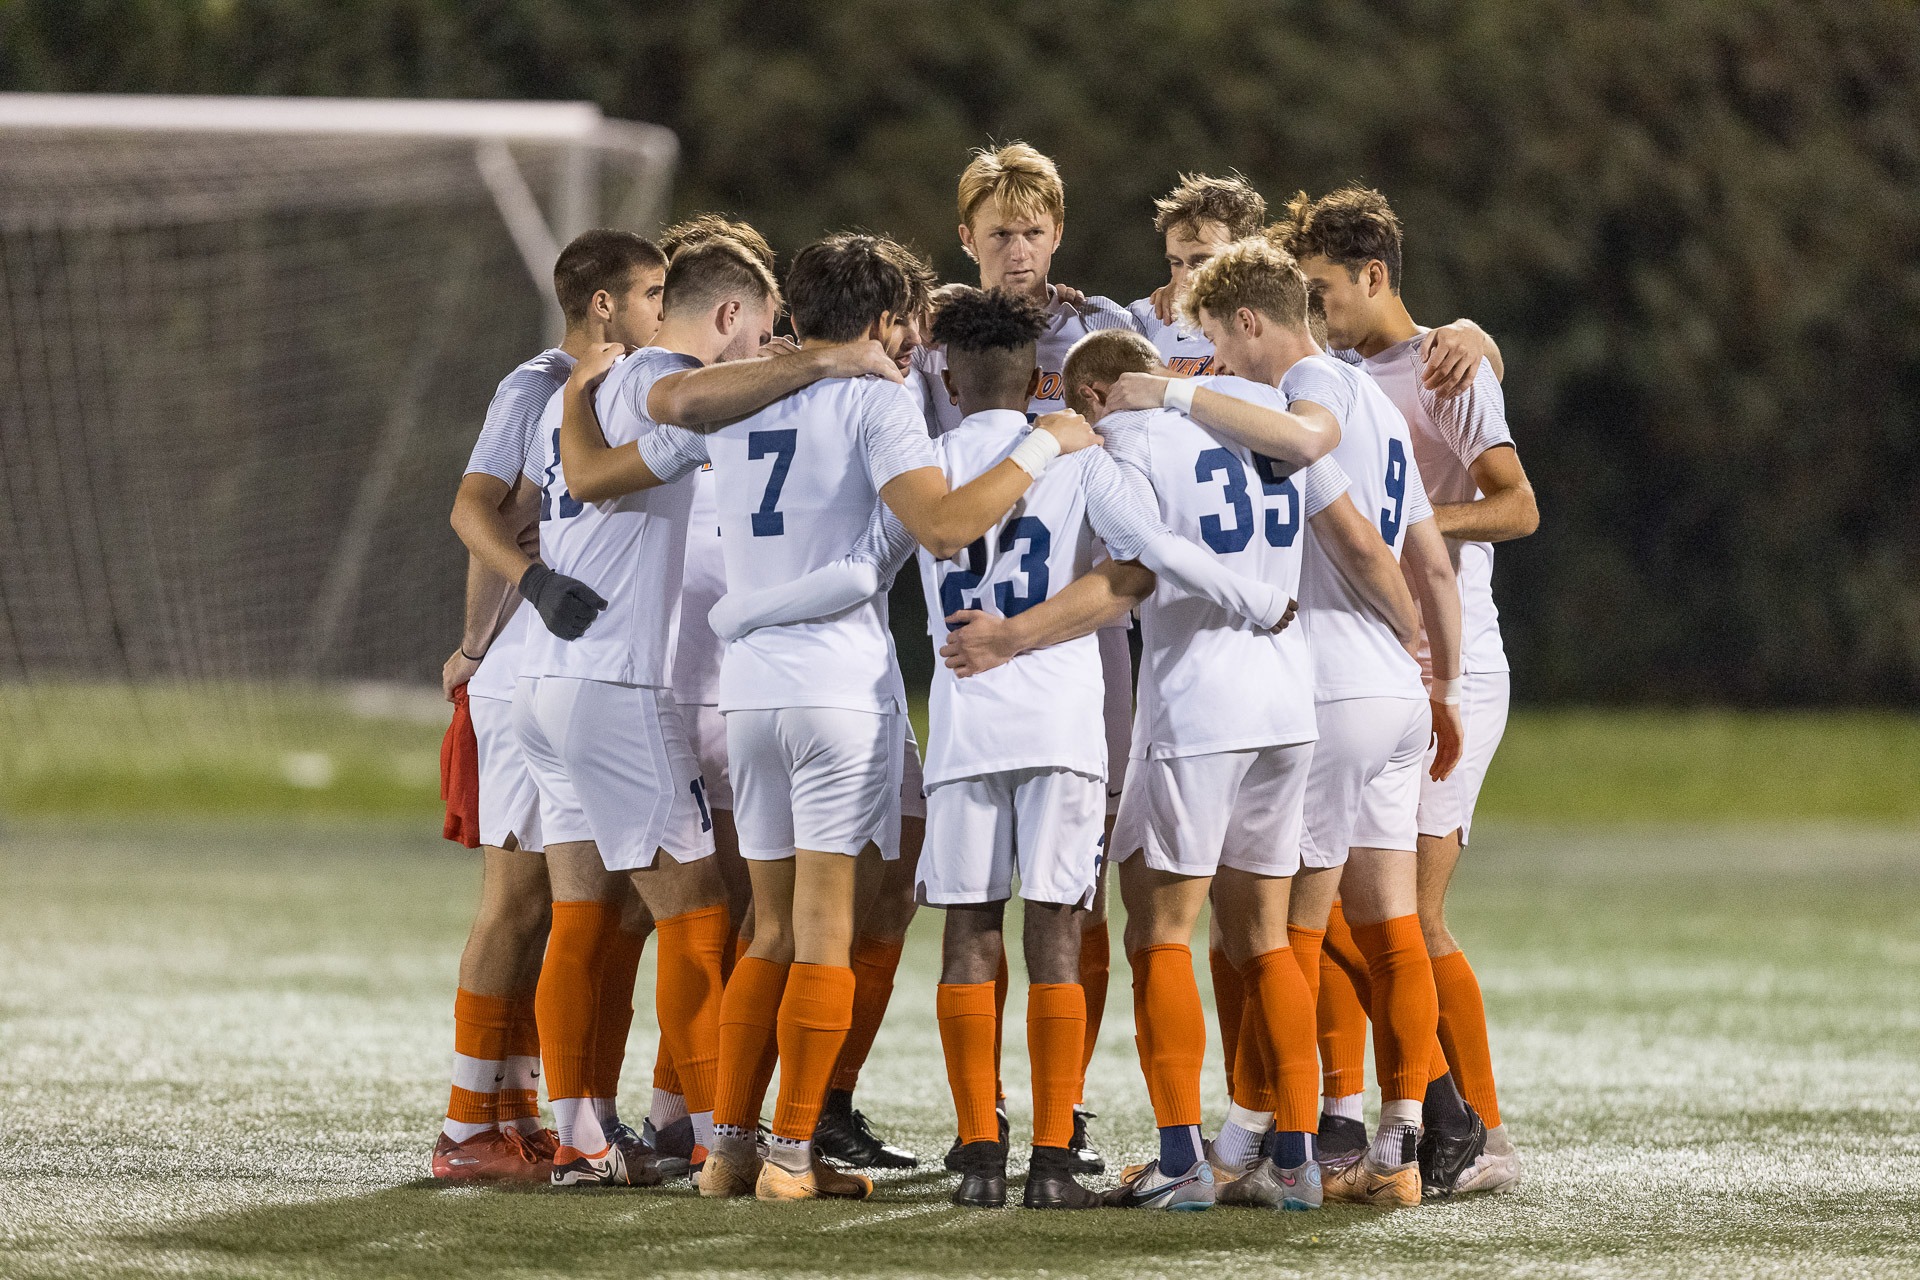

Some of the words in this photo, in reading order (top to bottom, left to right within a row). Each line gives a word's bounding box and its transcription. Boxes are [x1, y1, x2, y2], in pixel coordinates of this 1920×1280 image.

[747, 428, 798, 538] 7
[1194, 446, 1300, 555] 35
[1380, 437, 1407, 547] 9
